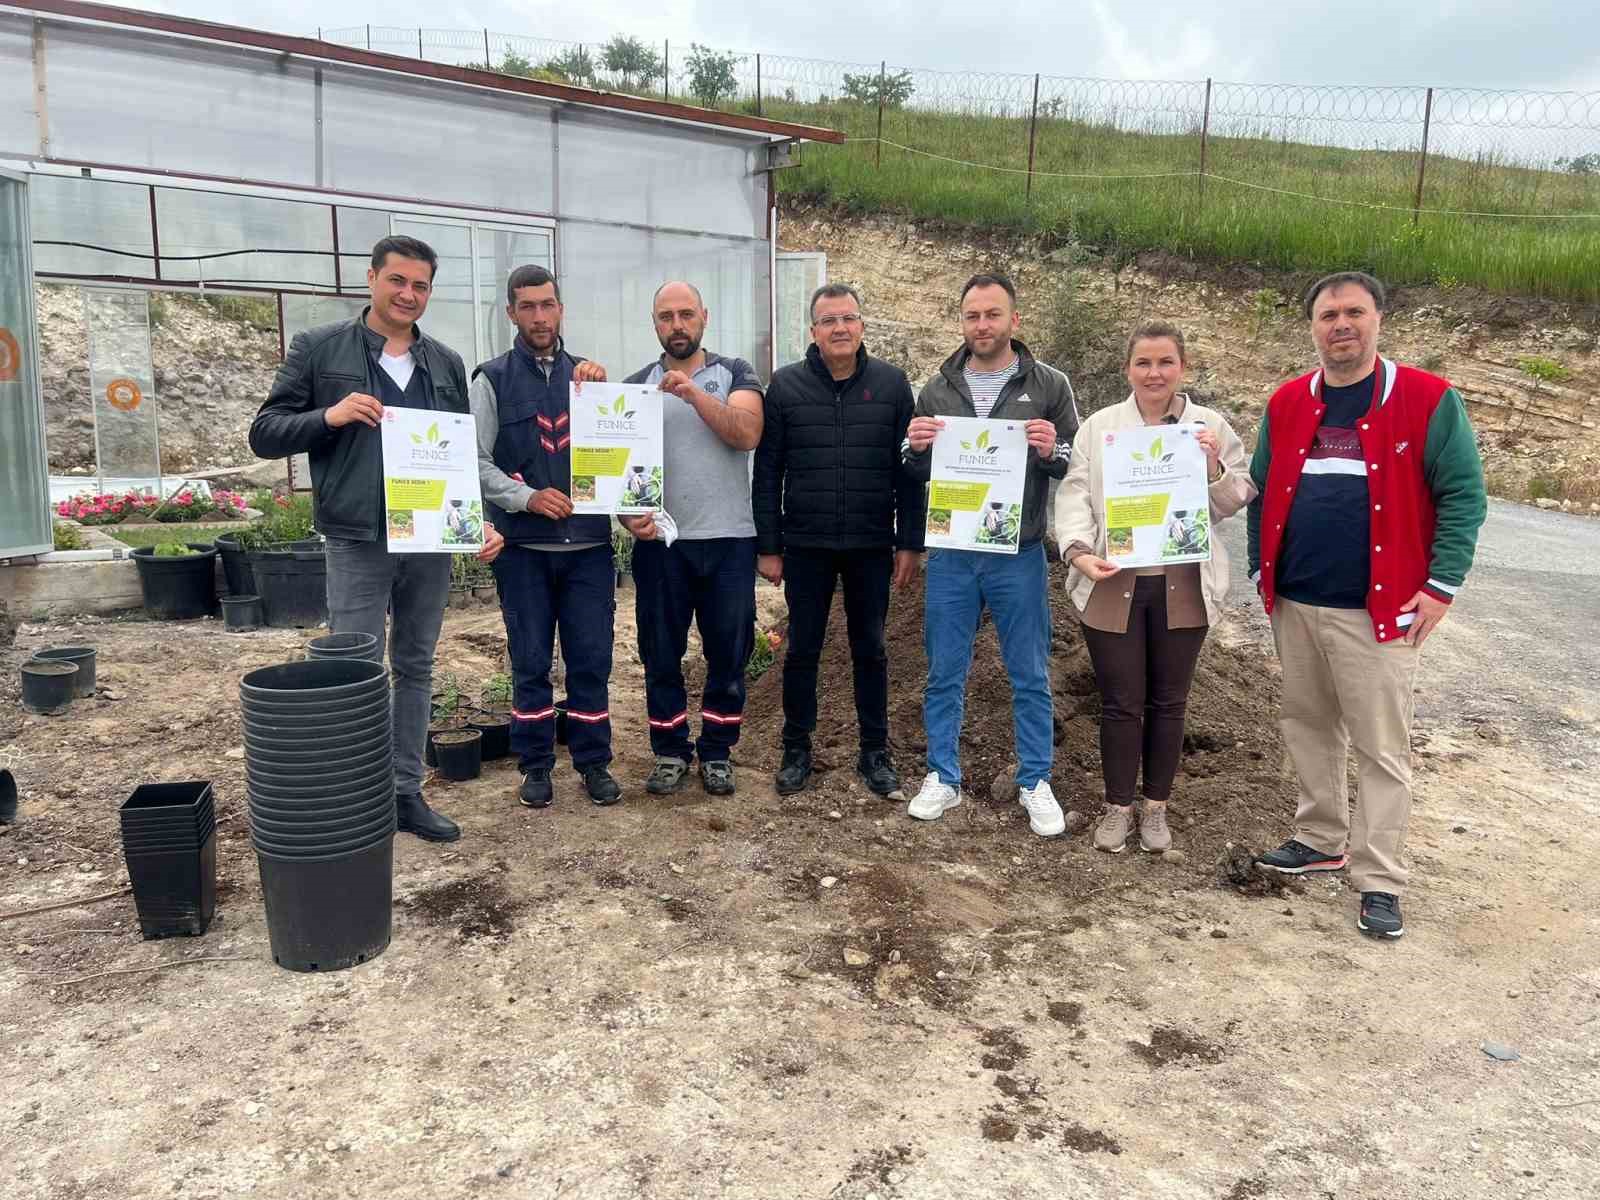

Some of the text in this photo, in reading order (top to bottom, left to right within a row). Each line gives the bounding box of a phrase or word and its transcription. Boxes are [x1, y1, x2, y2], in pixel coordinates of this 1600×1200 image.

[597, 420, 636, 430] FUNICE
[411, 449, 448, 460] FUNICE
[959, 454, 998, 465] FUNICE
[1132, 464, 1175, 477] FUNICE
